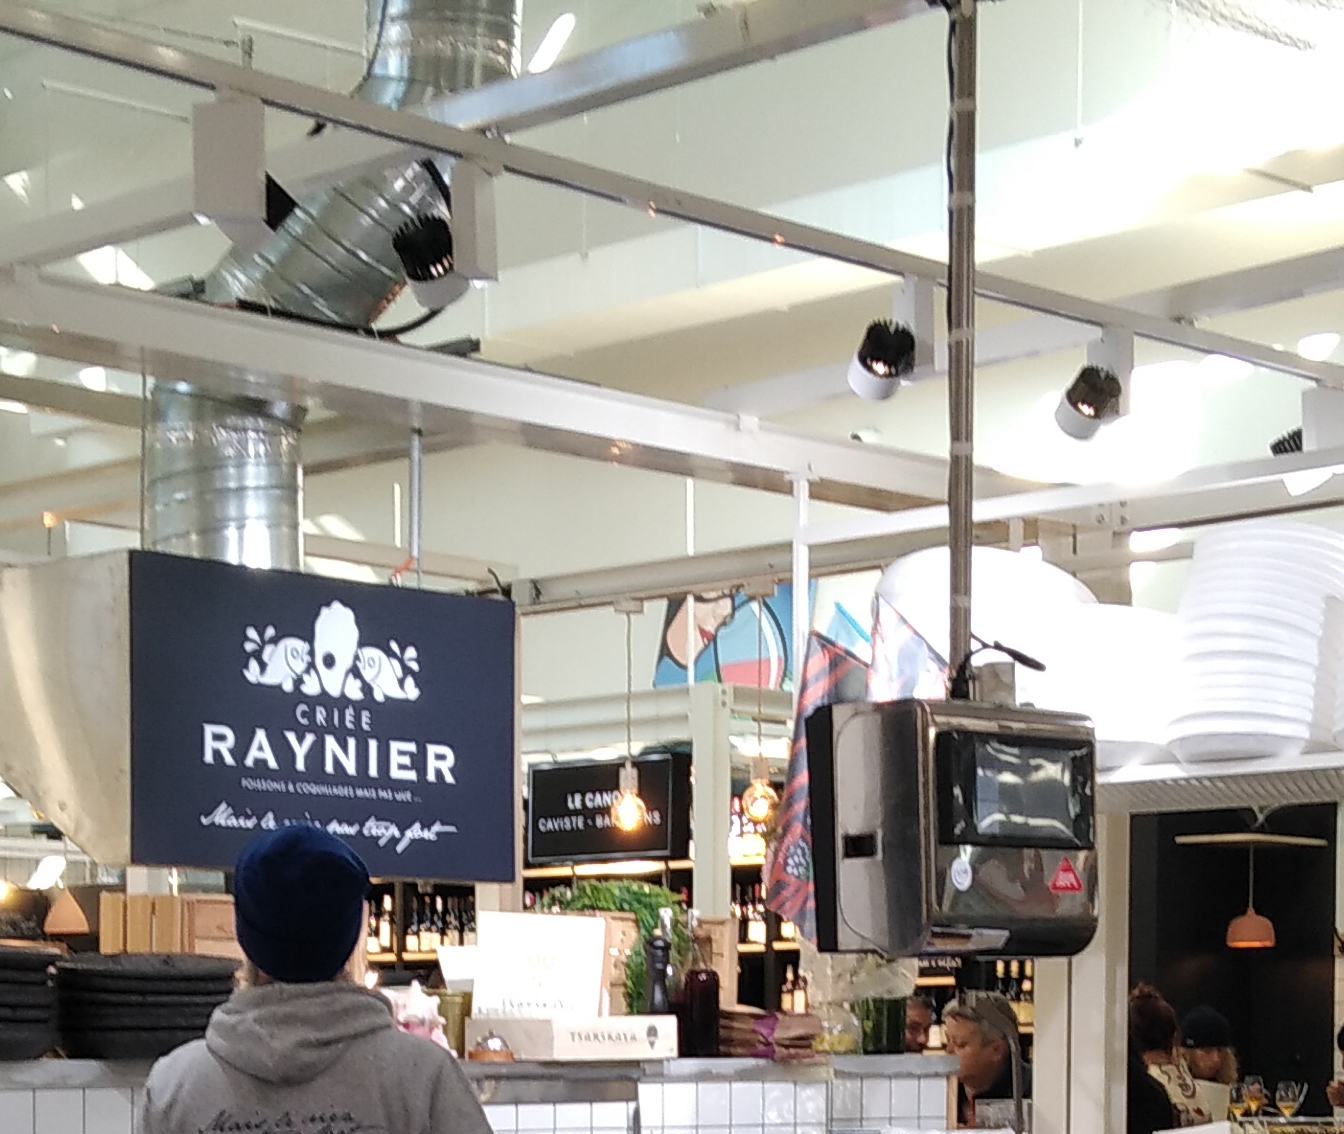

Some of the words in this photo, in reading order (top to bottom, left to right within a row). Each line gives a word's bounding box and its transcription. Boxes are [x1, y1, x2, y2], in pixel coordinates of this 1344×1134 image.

[202, 722, 456, 785] RAYNIER
[567, 792, 582, 811] LE
[584, 789, 628, 809] CANO
[538, 815, 585, 833] CAVISTE
